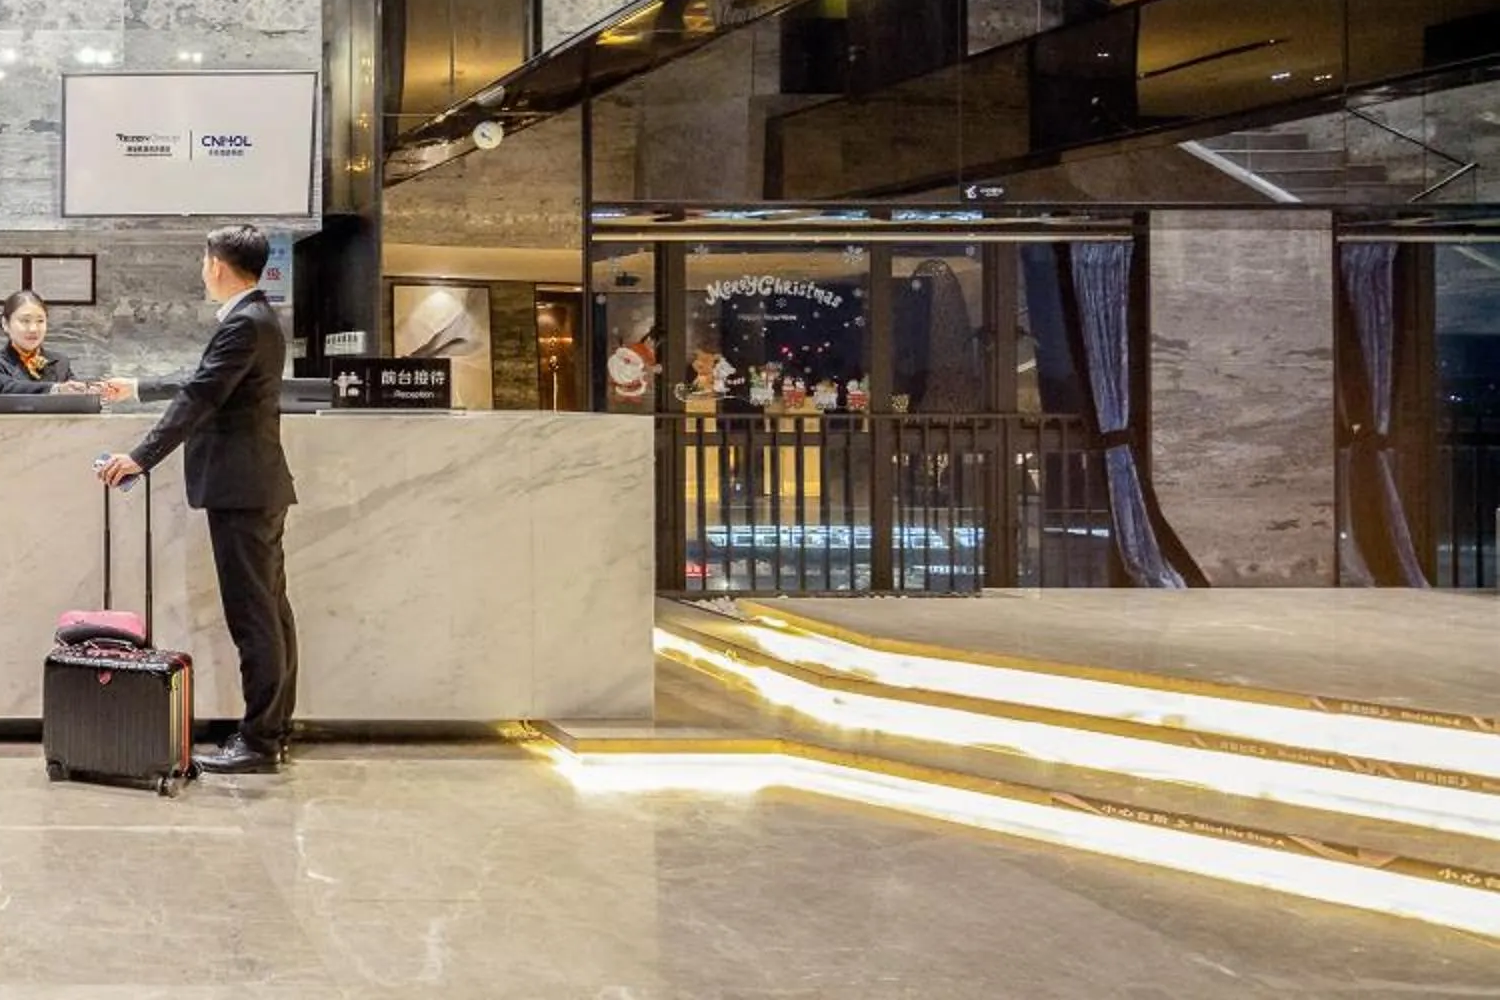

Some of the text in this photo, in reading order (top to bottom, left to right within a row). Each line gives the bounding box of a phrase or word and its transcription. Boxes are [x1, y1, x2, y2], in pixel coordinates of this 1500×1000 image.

[381, 369, 445, 386] 前台接待
[393, 389, 435, 399] Reception
